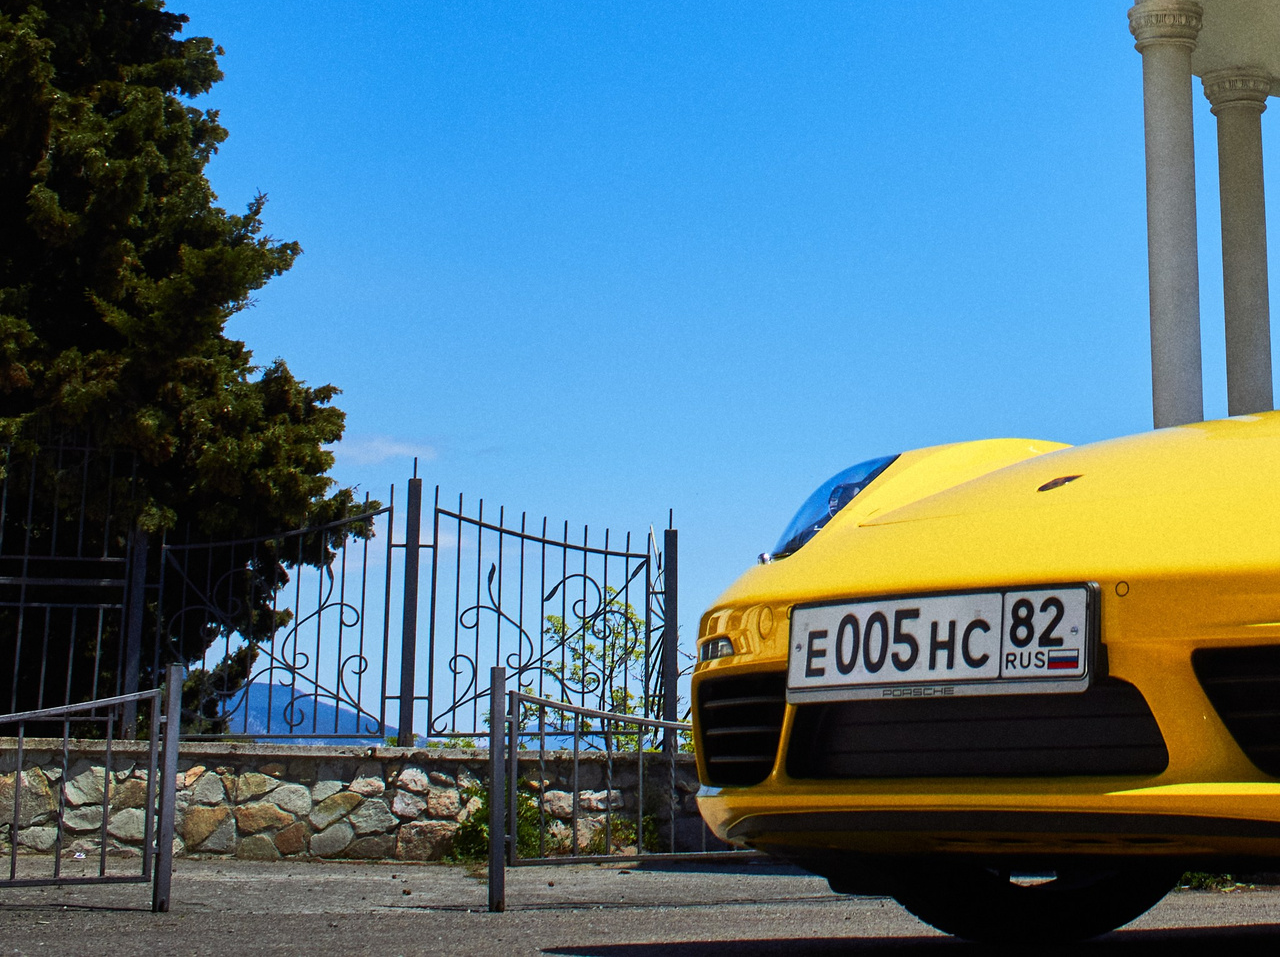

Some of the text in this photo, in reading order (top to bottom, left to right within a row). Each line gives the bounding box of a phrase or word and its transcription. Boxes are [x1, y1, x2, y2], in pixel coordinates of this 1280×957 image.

[1009, 596, 1065, 648] 82
[1005, 650, 1046, 670] RUS
[882, 686, 955, 697] PORSCHE
